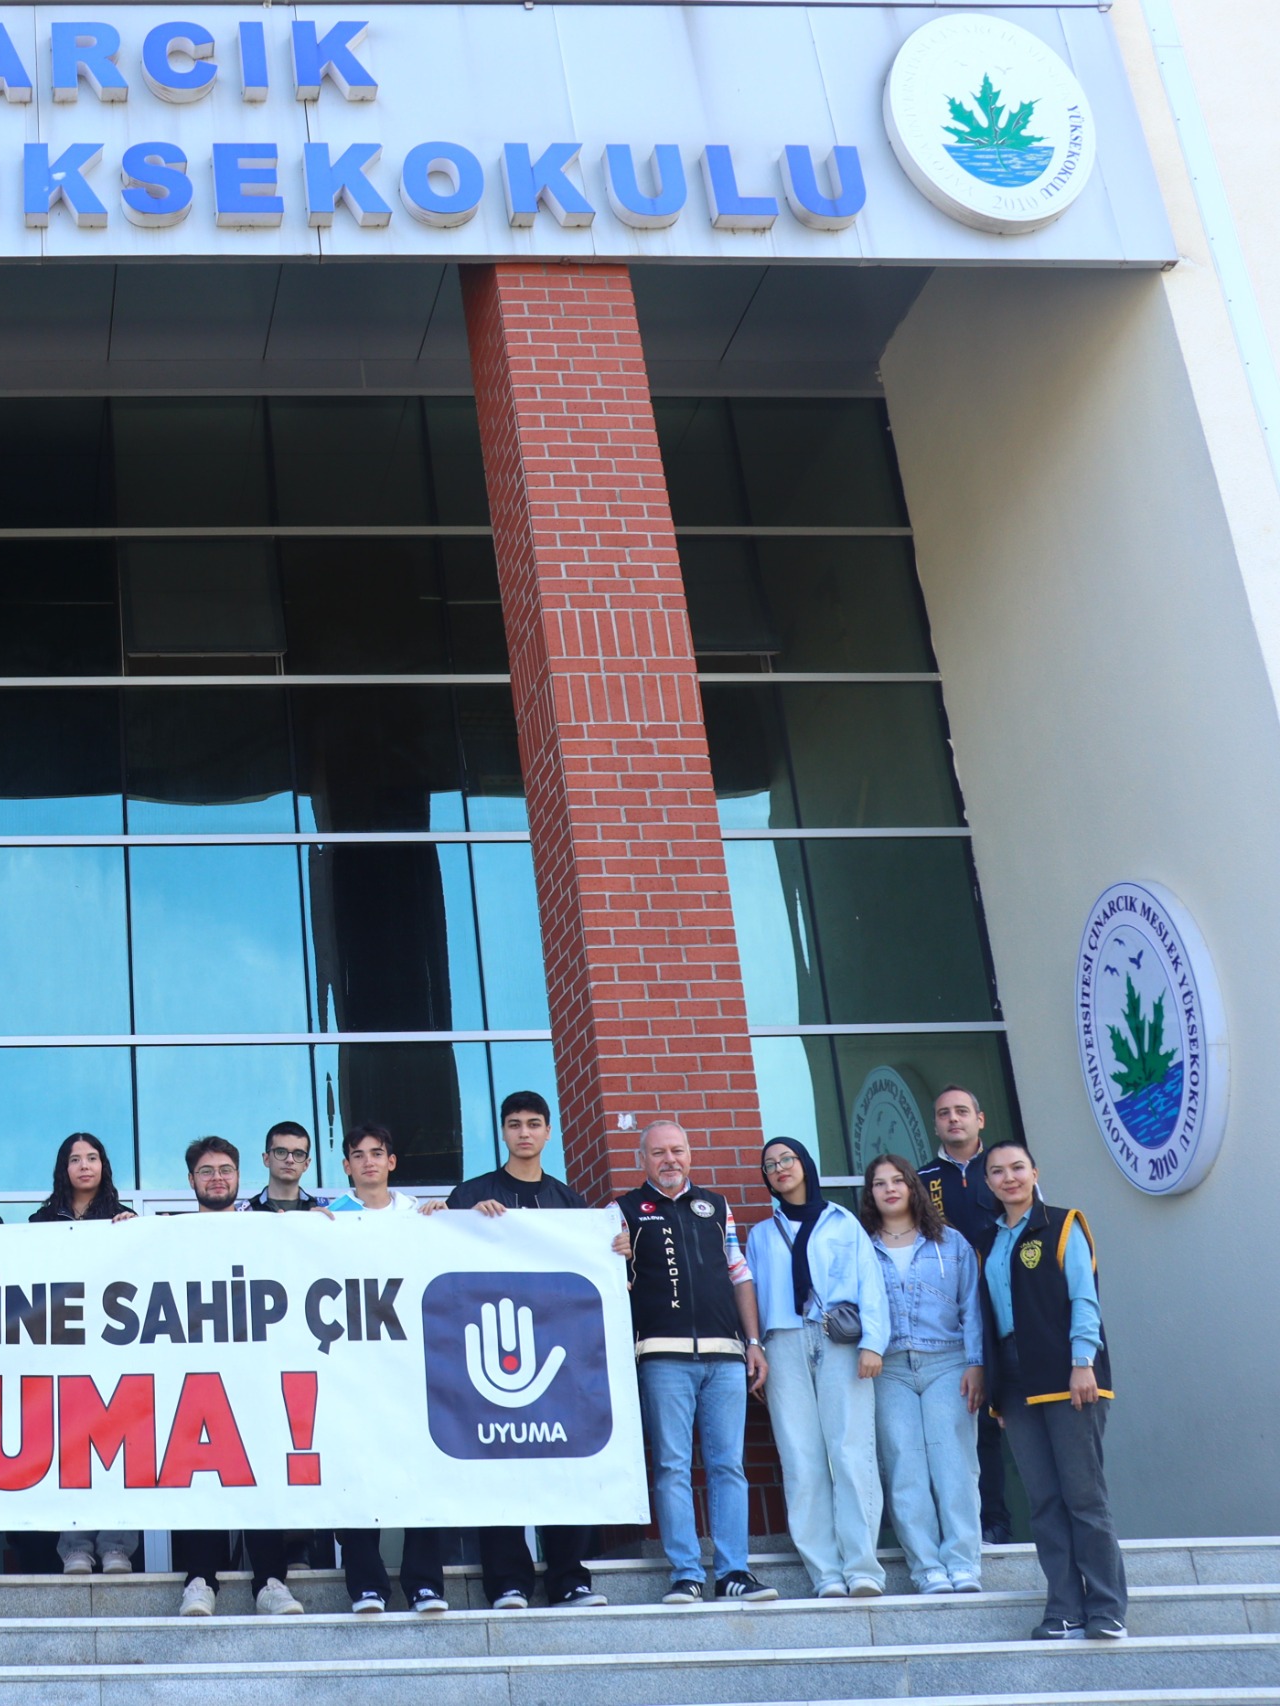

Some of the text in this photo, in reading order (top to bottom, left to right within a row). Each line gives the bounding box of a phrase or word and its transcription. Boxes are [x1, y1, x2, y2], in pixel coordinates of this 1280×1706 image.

[1040, 105, 1085, 200] YÜKSEKOKULU
[992, 195, 1039, 213] 2010
[1082, 895, 1199, 1173] YALOVA ÜNİVERSİTESİ ÇINARCIK MESLEK YÜKSEKOKULU
[1148, 1148, 1179, 1182] 2010
[638, 1214, 665, 1222] YALOVA
[662, 1227, 680, 1308] NARKOTİK
[100, 1264, 288, 1346] SAHİP
[304, 1276, 408, 1354] ÇIK
[280, 1370, 321, 1487] !
[476, 1421, 568, 1445] UYUMA
